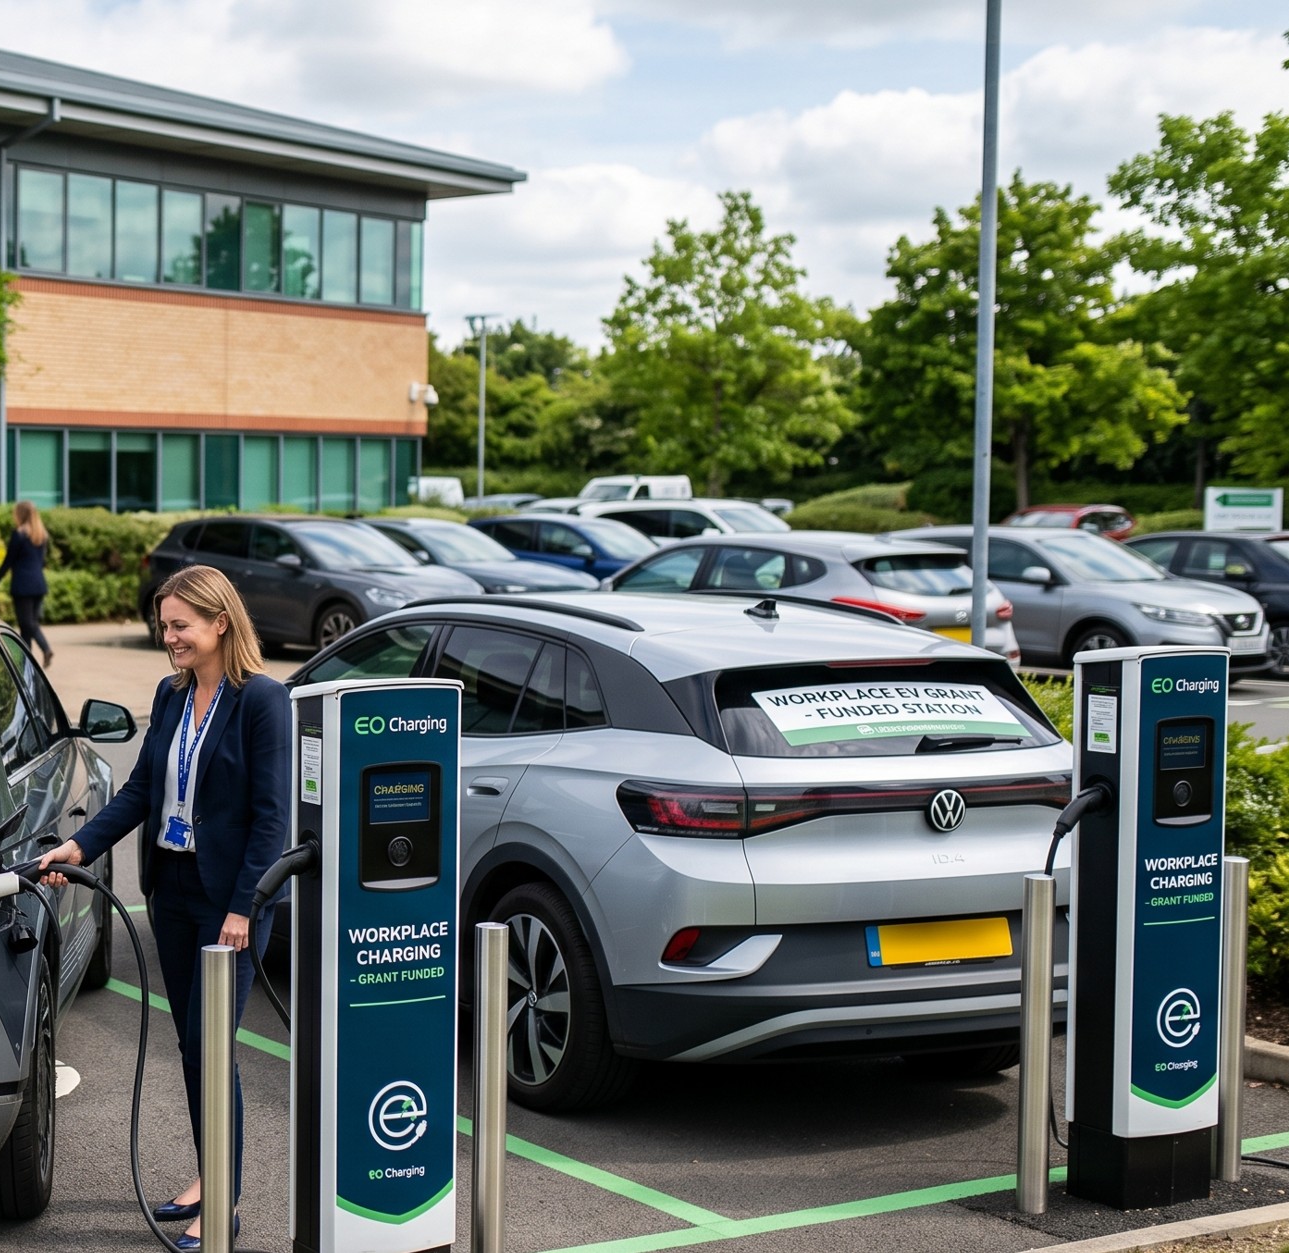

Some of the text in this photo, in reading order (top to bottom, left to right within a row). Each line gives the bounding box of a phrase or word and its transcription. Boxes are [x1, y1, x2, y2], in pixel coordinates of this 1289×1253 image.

[1151, 677, 1220, 694] EO Charging
[767, 687, 985, 707] WORKPLACE EV GRANT
[818, 704, 899, 719] FUNDED
[901, 703, 983, 716] STATION
[354, 715, 447, 735] EO Charging
[931, 853, 965, 865] ID.4
[1144, 853, 1218, 871] WORKPLACE
[1150, 871, 1213, 890] CHARGING
[1150, 895, 1182, 907] GRANT
[348, 921, 449, 944] WORKPLACE
[356, 943, 441, 966] CHARGING
[358, 971, 399, 985] GRANT
[401, 966, 445, 982] FUNDED
[385, 1164, 425, 1178] Charging
